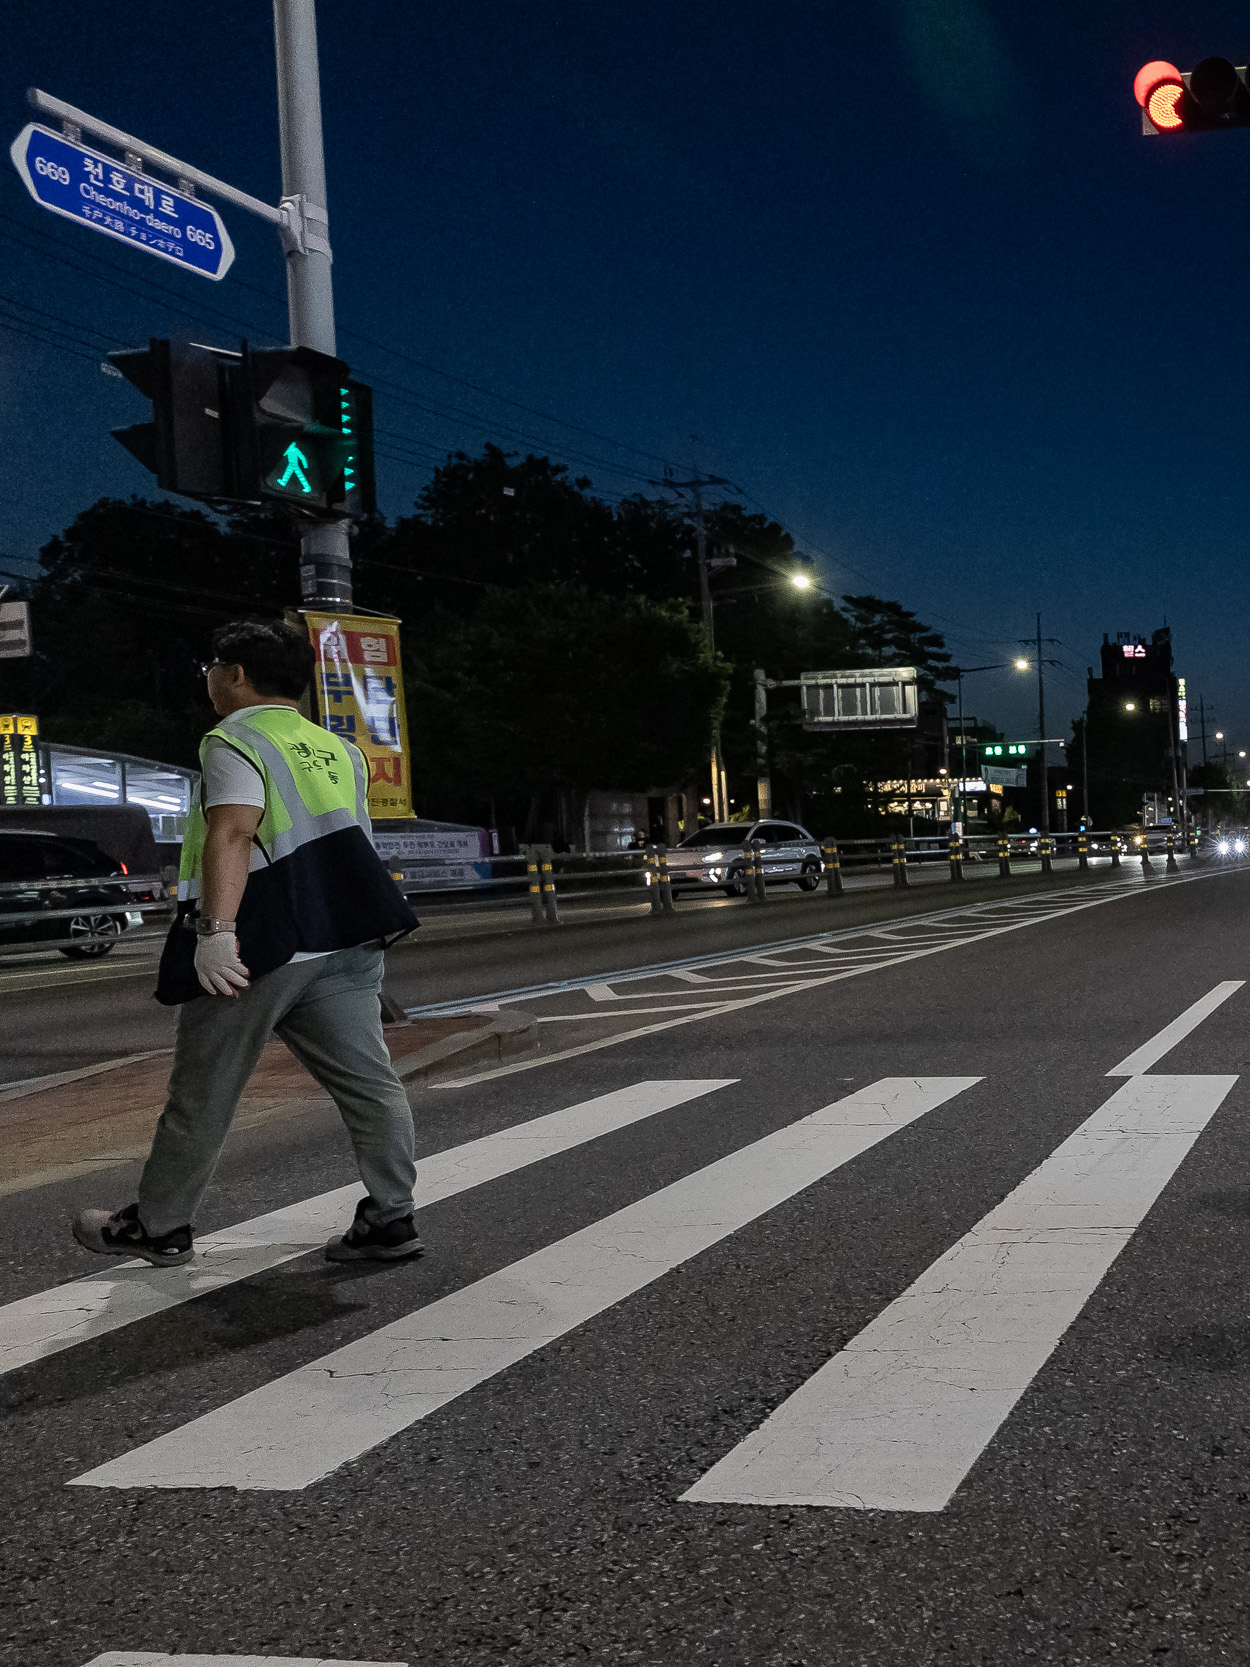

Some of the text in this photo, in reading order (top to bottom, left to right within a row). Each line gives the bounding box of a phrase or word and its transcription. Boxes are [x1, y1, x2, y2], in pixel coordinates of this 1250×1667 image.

[34, 156, 71, 186] 669
[83, 157, 179, 218] 천호대로
[79, 183, 183, 238] Cheonho-daero
[186, 225, 216, 250] 665
[370, 757, 402, 787] 지
